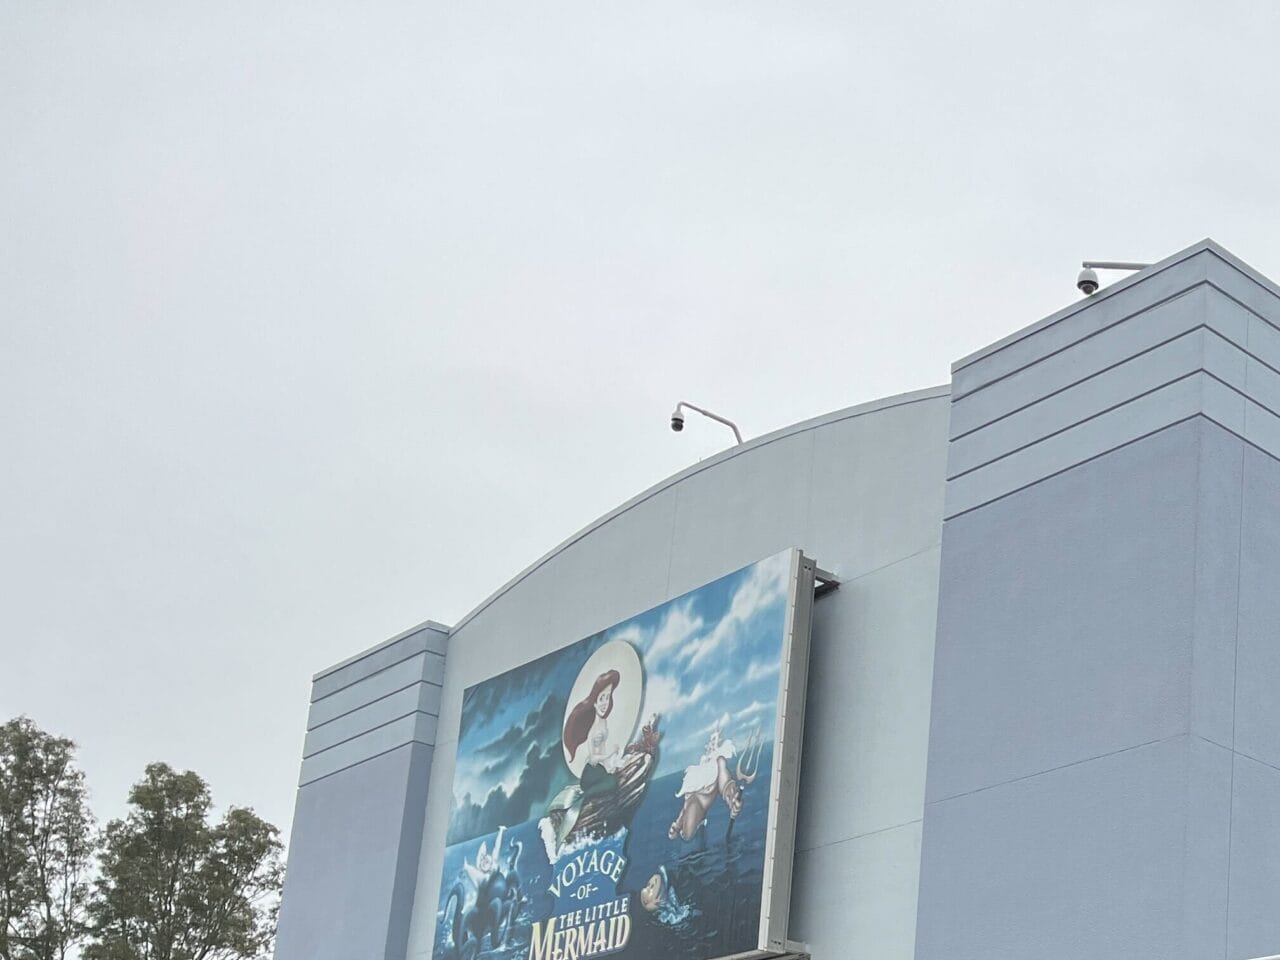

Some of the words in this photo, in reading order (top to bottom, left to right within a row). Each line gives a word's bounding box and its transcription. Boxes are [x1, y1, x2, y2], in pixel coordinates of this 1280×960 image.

[548, 849, 626, 898] VOYAGE
[559, 909, 583, 929] THE
[584, 897, 629, 923] LITTLE
